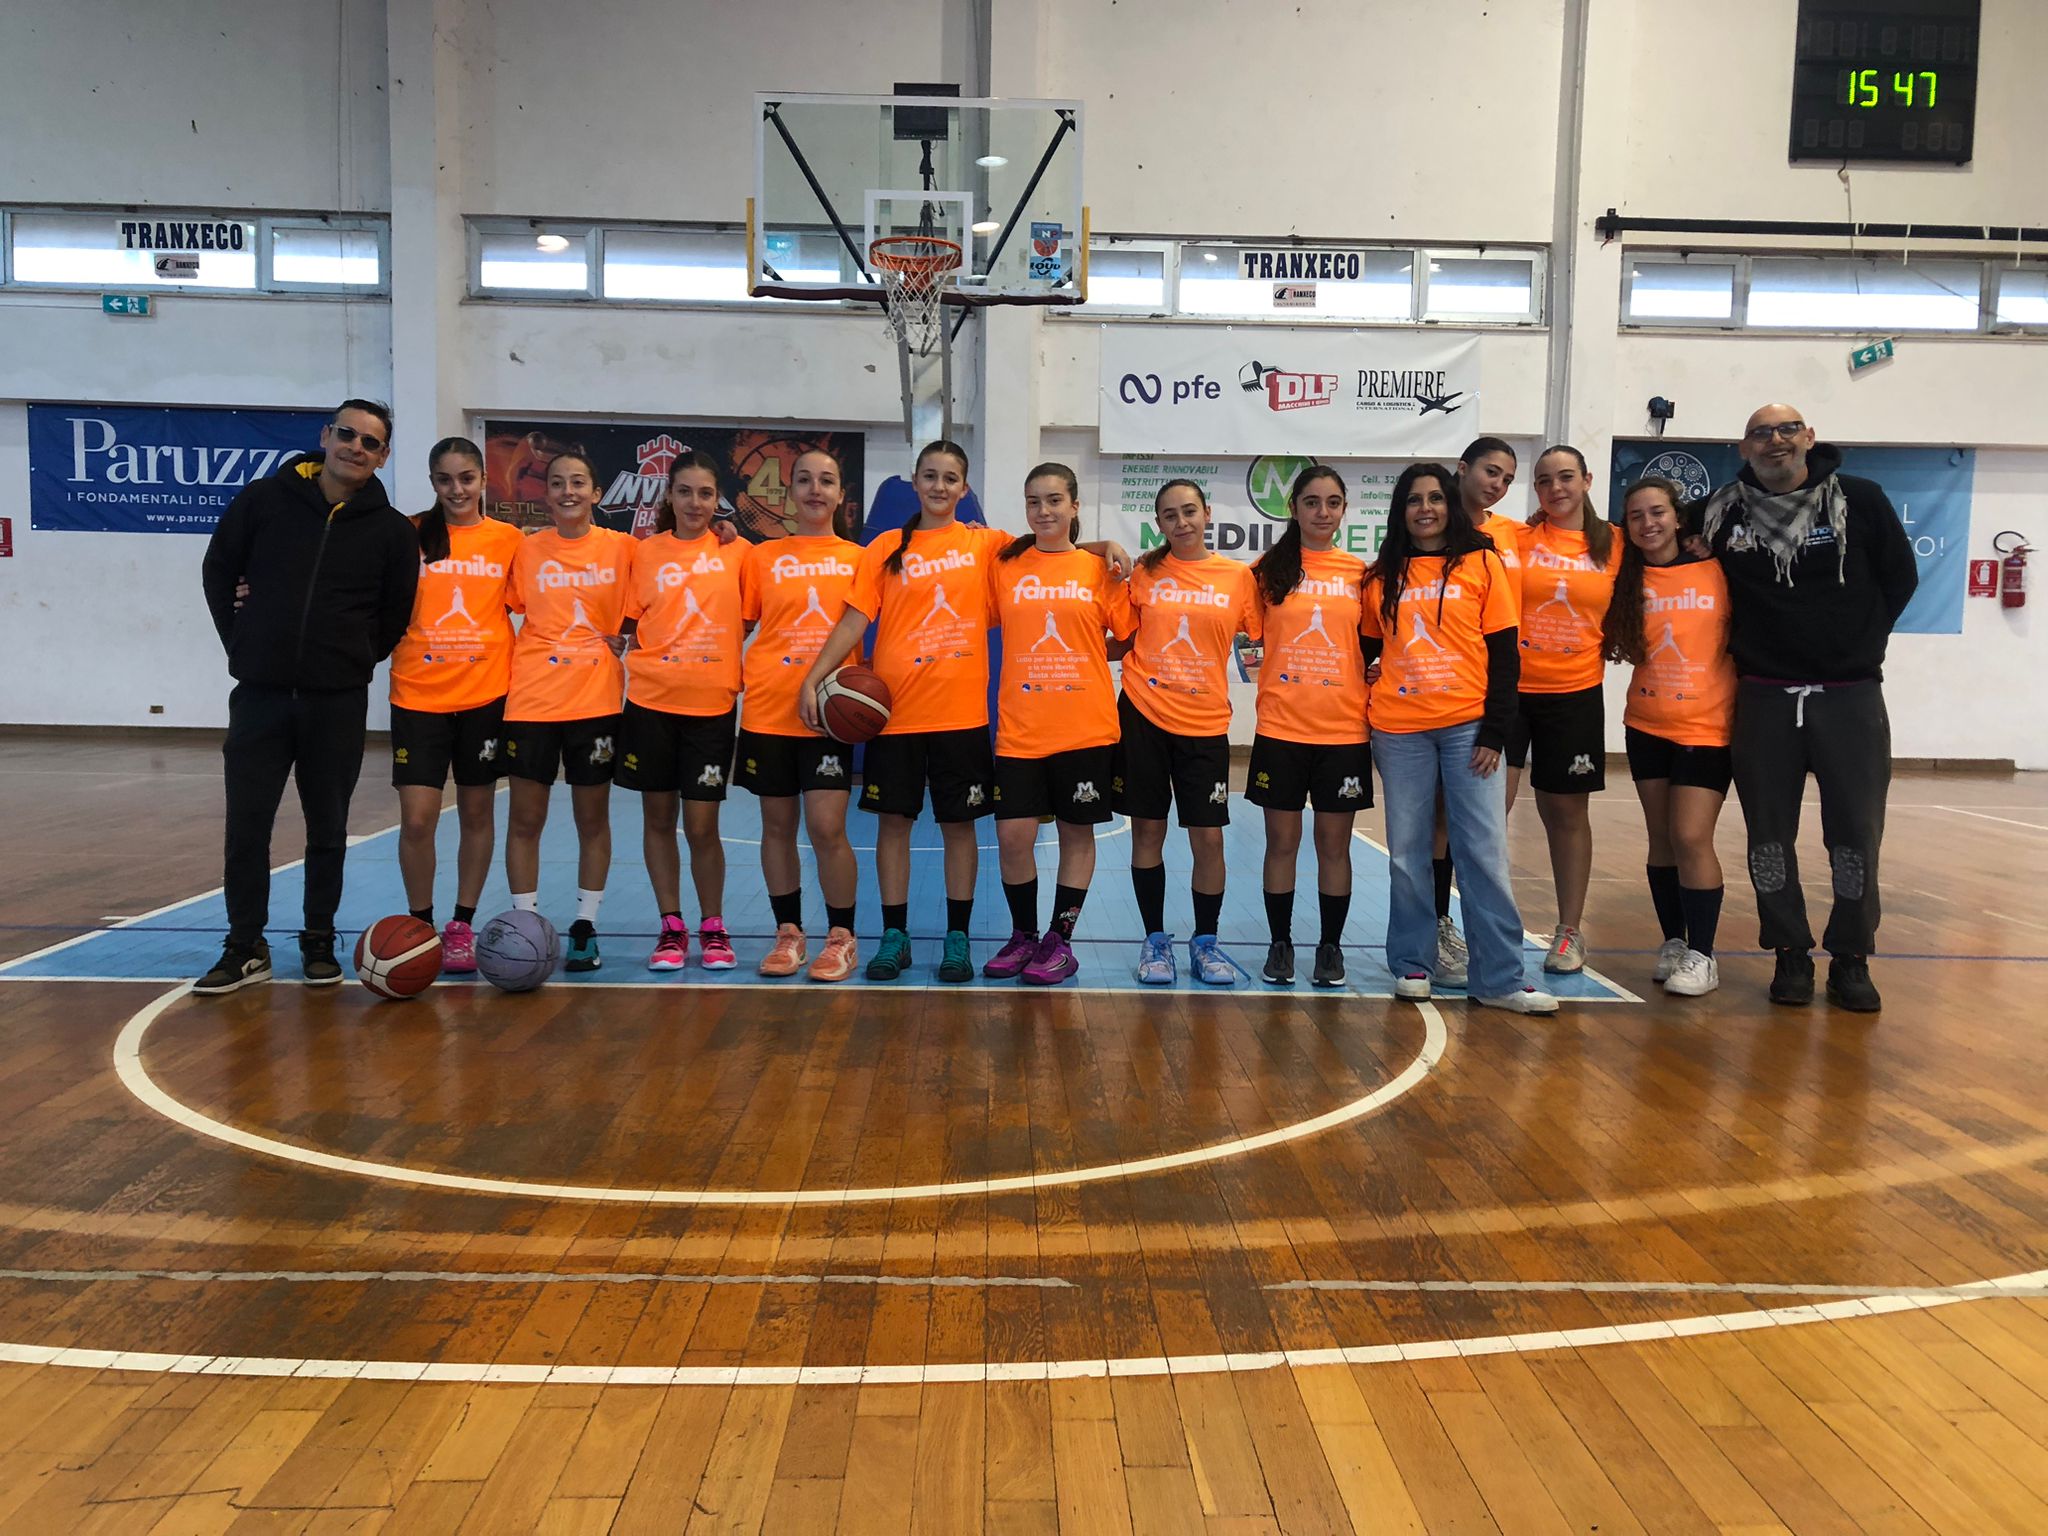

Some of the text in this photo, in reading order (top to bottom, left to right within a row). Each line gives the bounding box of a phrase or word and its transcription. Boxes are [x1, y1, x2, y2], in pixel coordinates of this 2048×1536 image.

[1849, 69, 1937, 108] 15 47
[122, 222, 243, 250] TRANXECO
[1244, 253, 1360, 280] TRANXECO
[1173, 374, 1221, 404] pfe
[1276, 374, 1338, 403] DLF
[1357, 370, 1446, 398] PREMIERE
[1122, 465, 1219, 474] ENERGIE RINNOVABILI
[77, 492, 192, 505] FONDAMENTALI
[199, 495, 225, 506] DEL
[146, 514, 220, 524] www.paruzz
[771, 554, 854, 584] famila
[1527, 543, 1606, 573] famil
[535, 560, 617, 593] famila
[1013, 575, 1093, 604] famila
[1291, 575, 1359, 600] amila
[1149, 577, 1230, 609] famila
